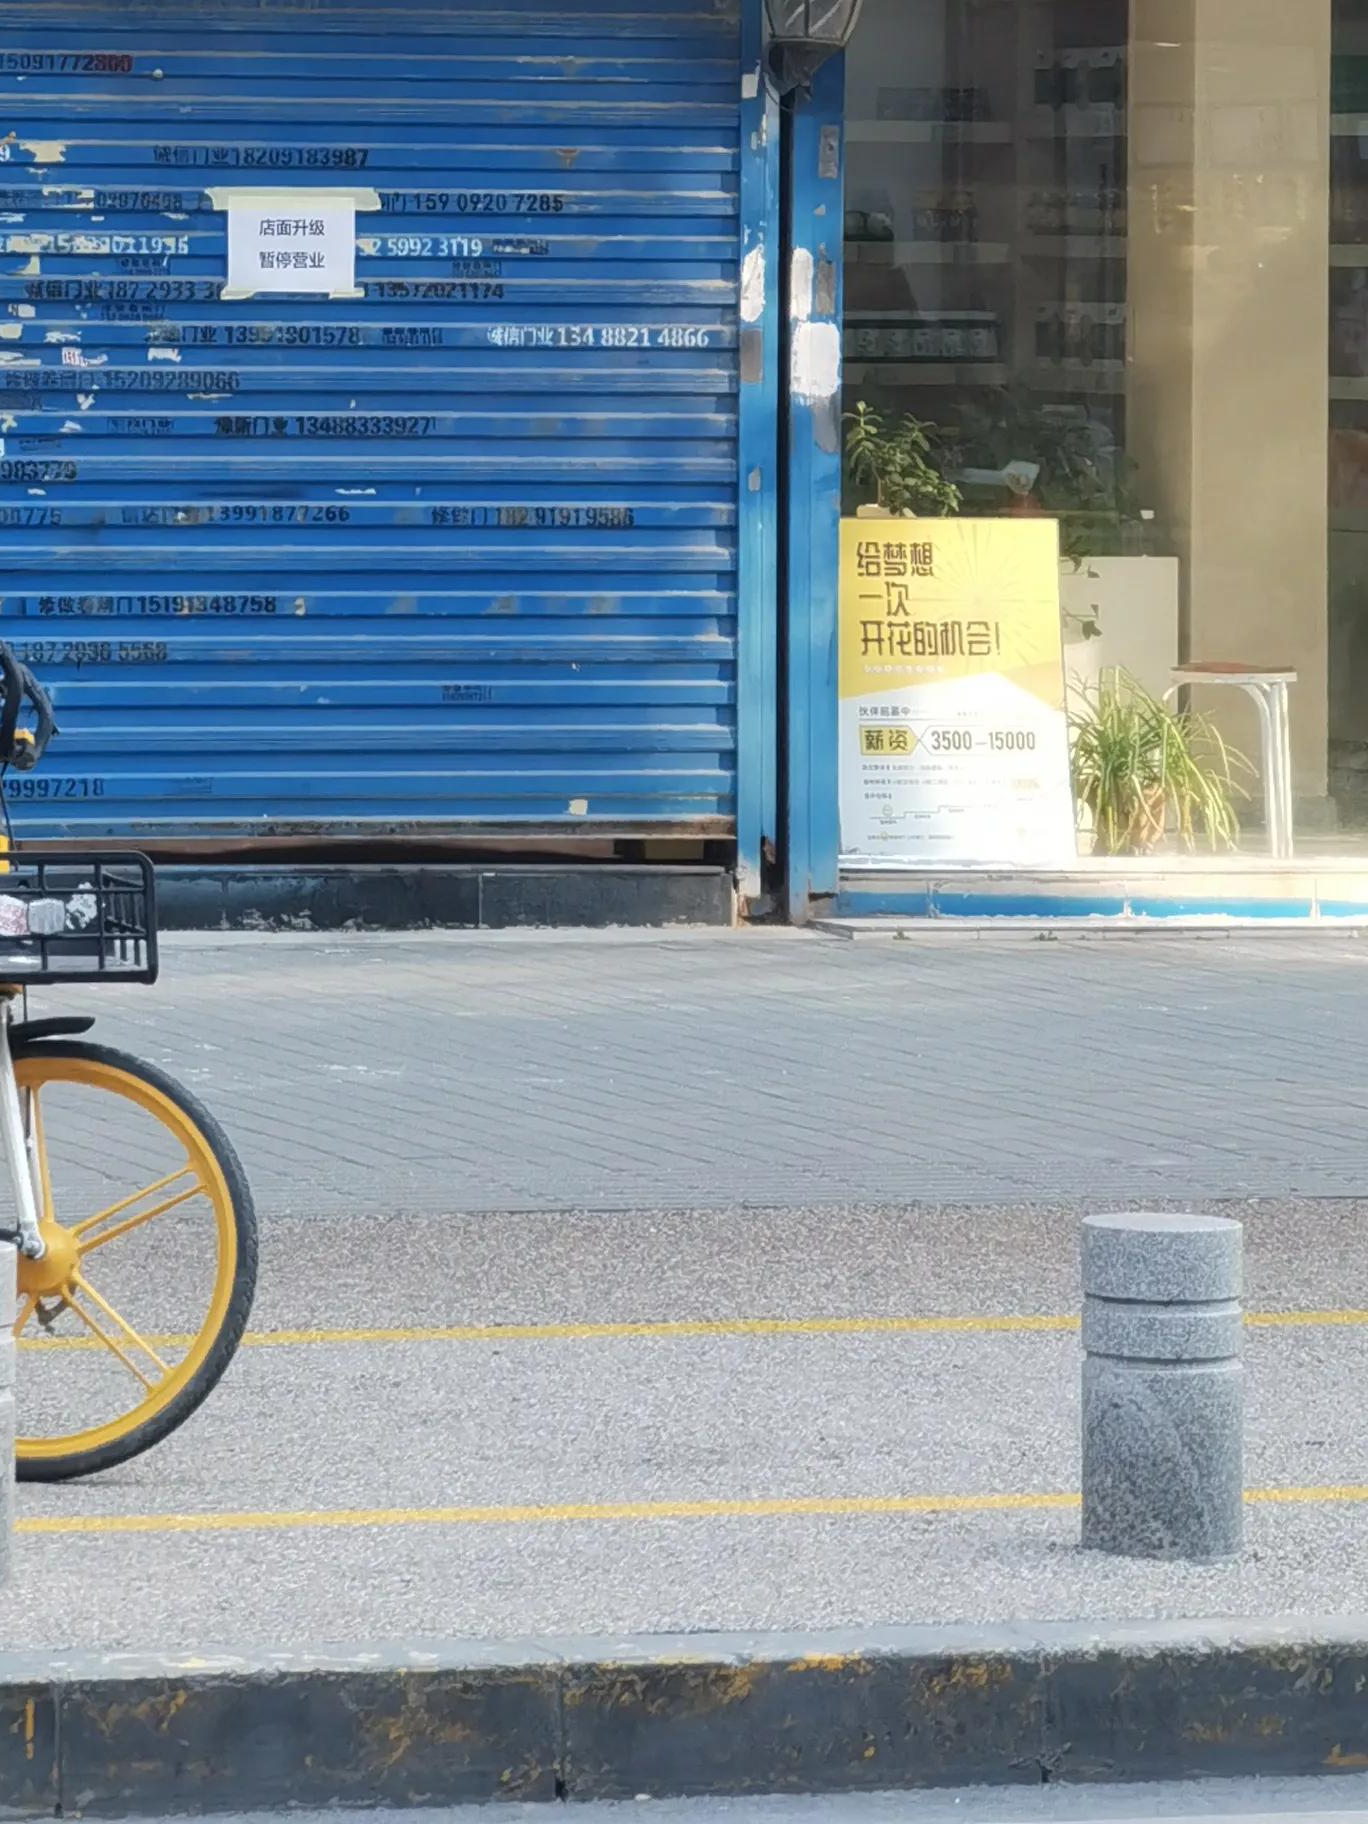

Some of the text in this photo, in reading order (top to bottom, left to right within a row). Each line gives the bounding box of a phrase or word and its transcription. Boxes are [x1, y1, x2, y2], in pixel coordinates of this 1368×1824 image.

[258, 218, 325, 238] 店面升级
[258, 251, 325, 271] 暂停营业
[557, 327, 595, 347] 134
[857, 542, 934, 577] 给梦想
[858, 581, 911, 617] 一次
